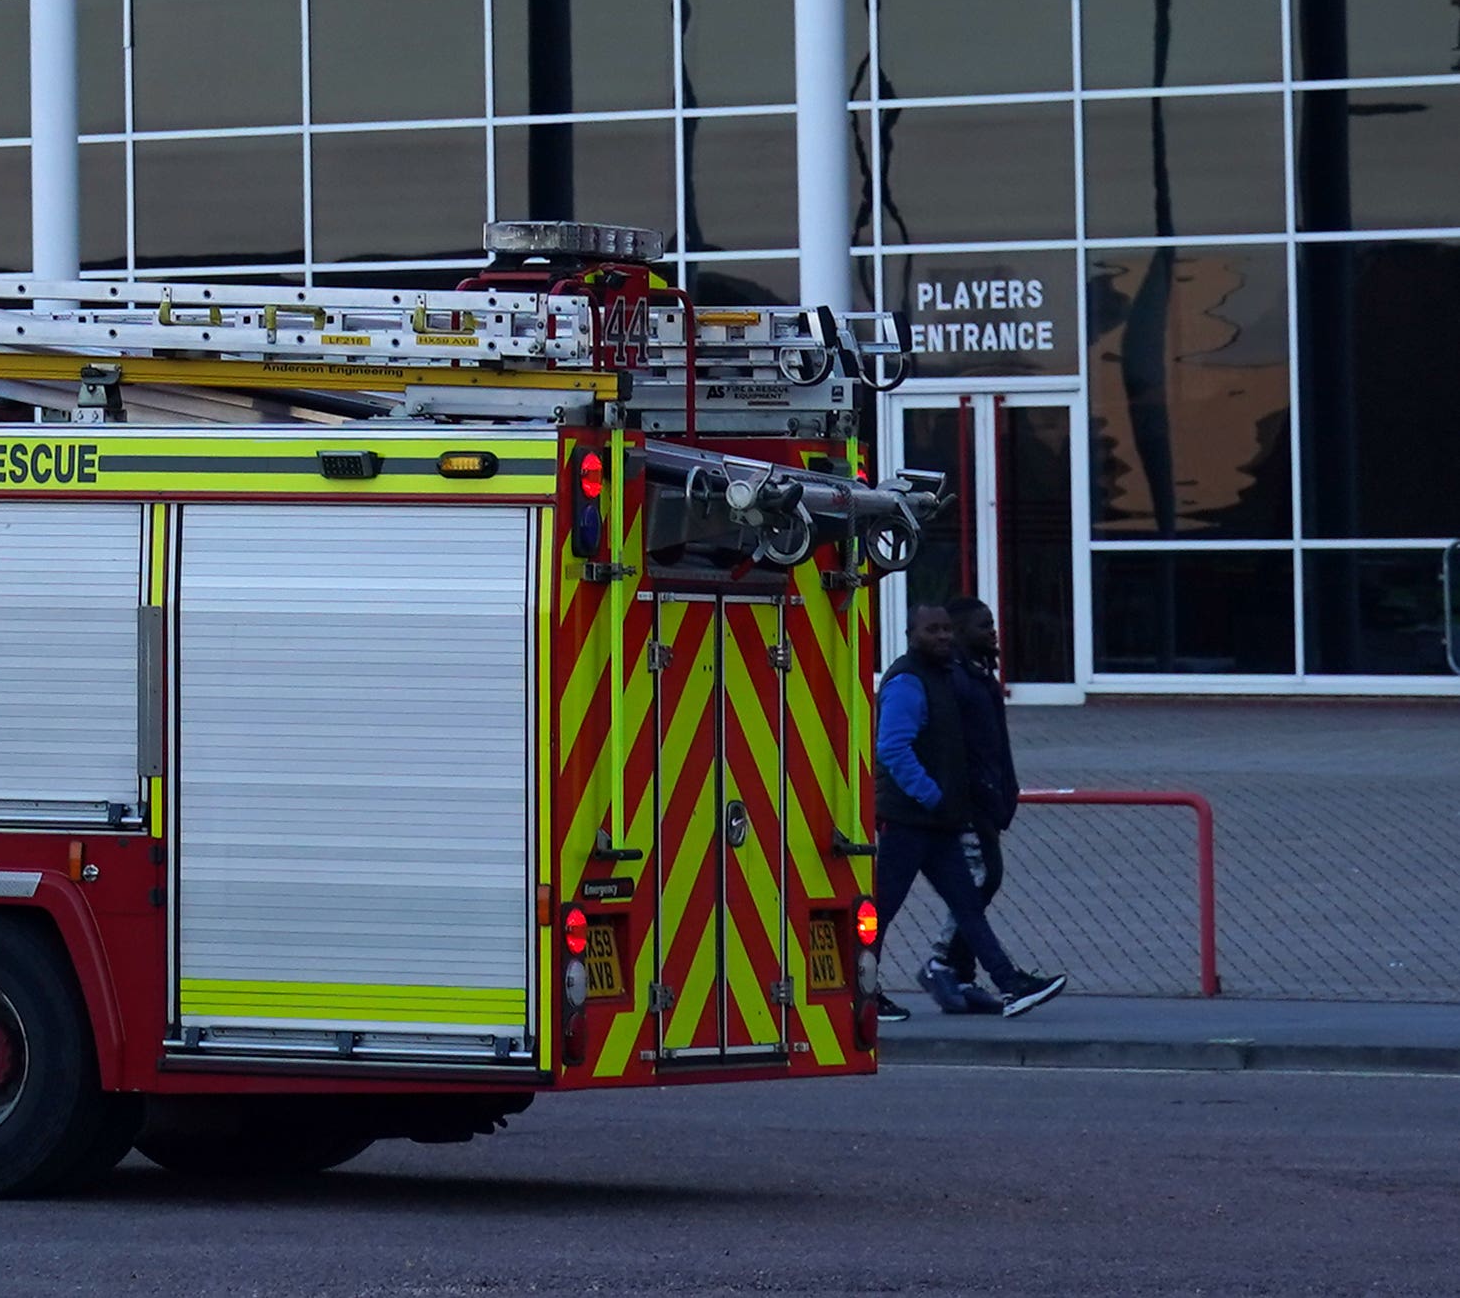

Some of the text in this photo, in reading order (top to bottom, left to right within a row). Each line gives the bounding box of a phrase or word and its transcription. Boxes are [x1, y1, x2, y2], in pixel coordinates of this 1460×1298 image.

[918, 279, 1043, 311] PLAYERS
[605, 295, 649, 366] 44
[911, 321, 1054, 353] ENTRANCE
[263, 363, 403, 377] Anderson Engineering
[584, 884, 618, 897] Emergency
[586, 930, 613, 957] X59
